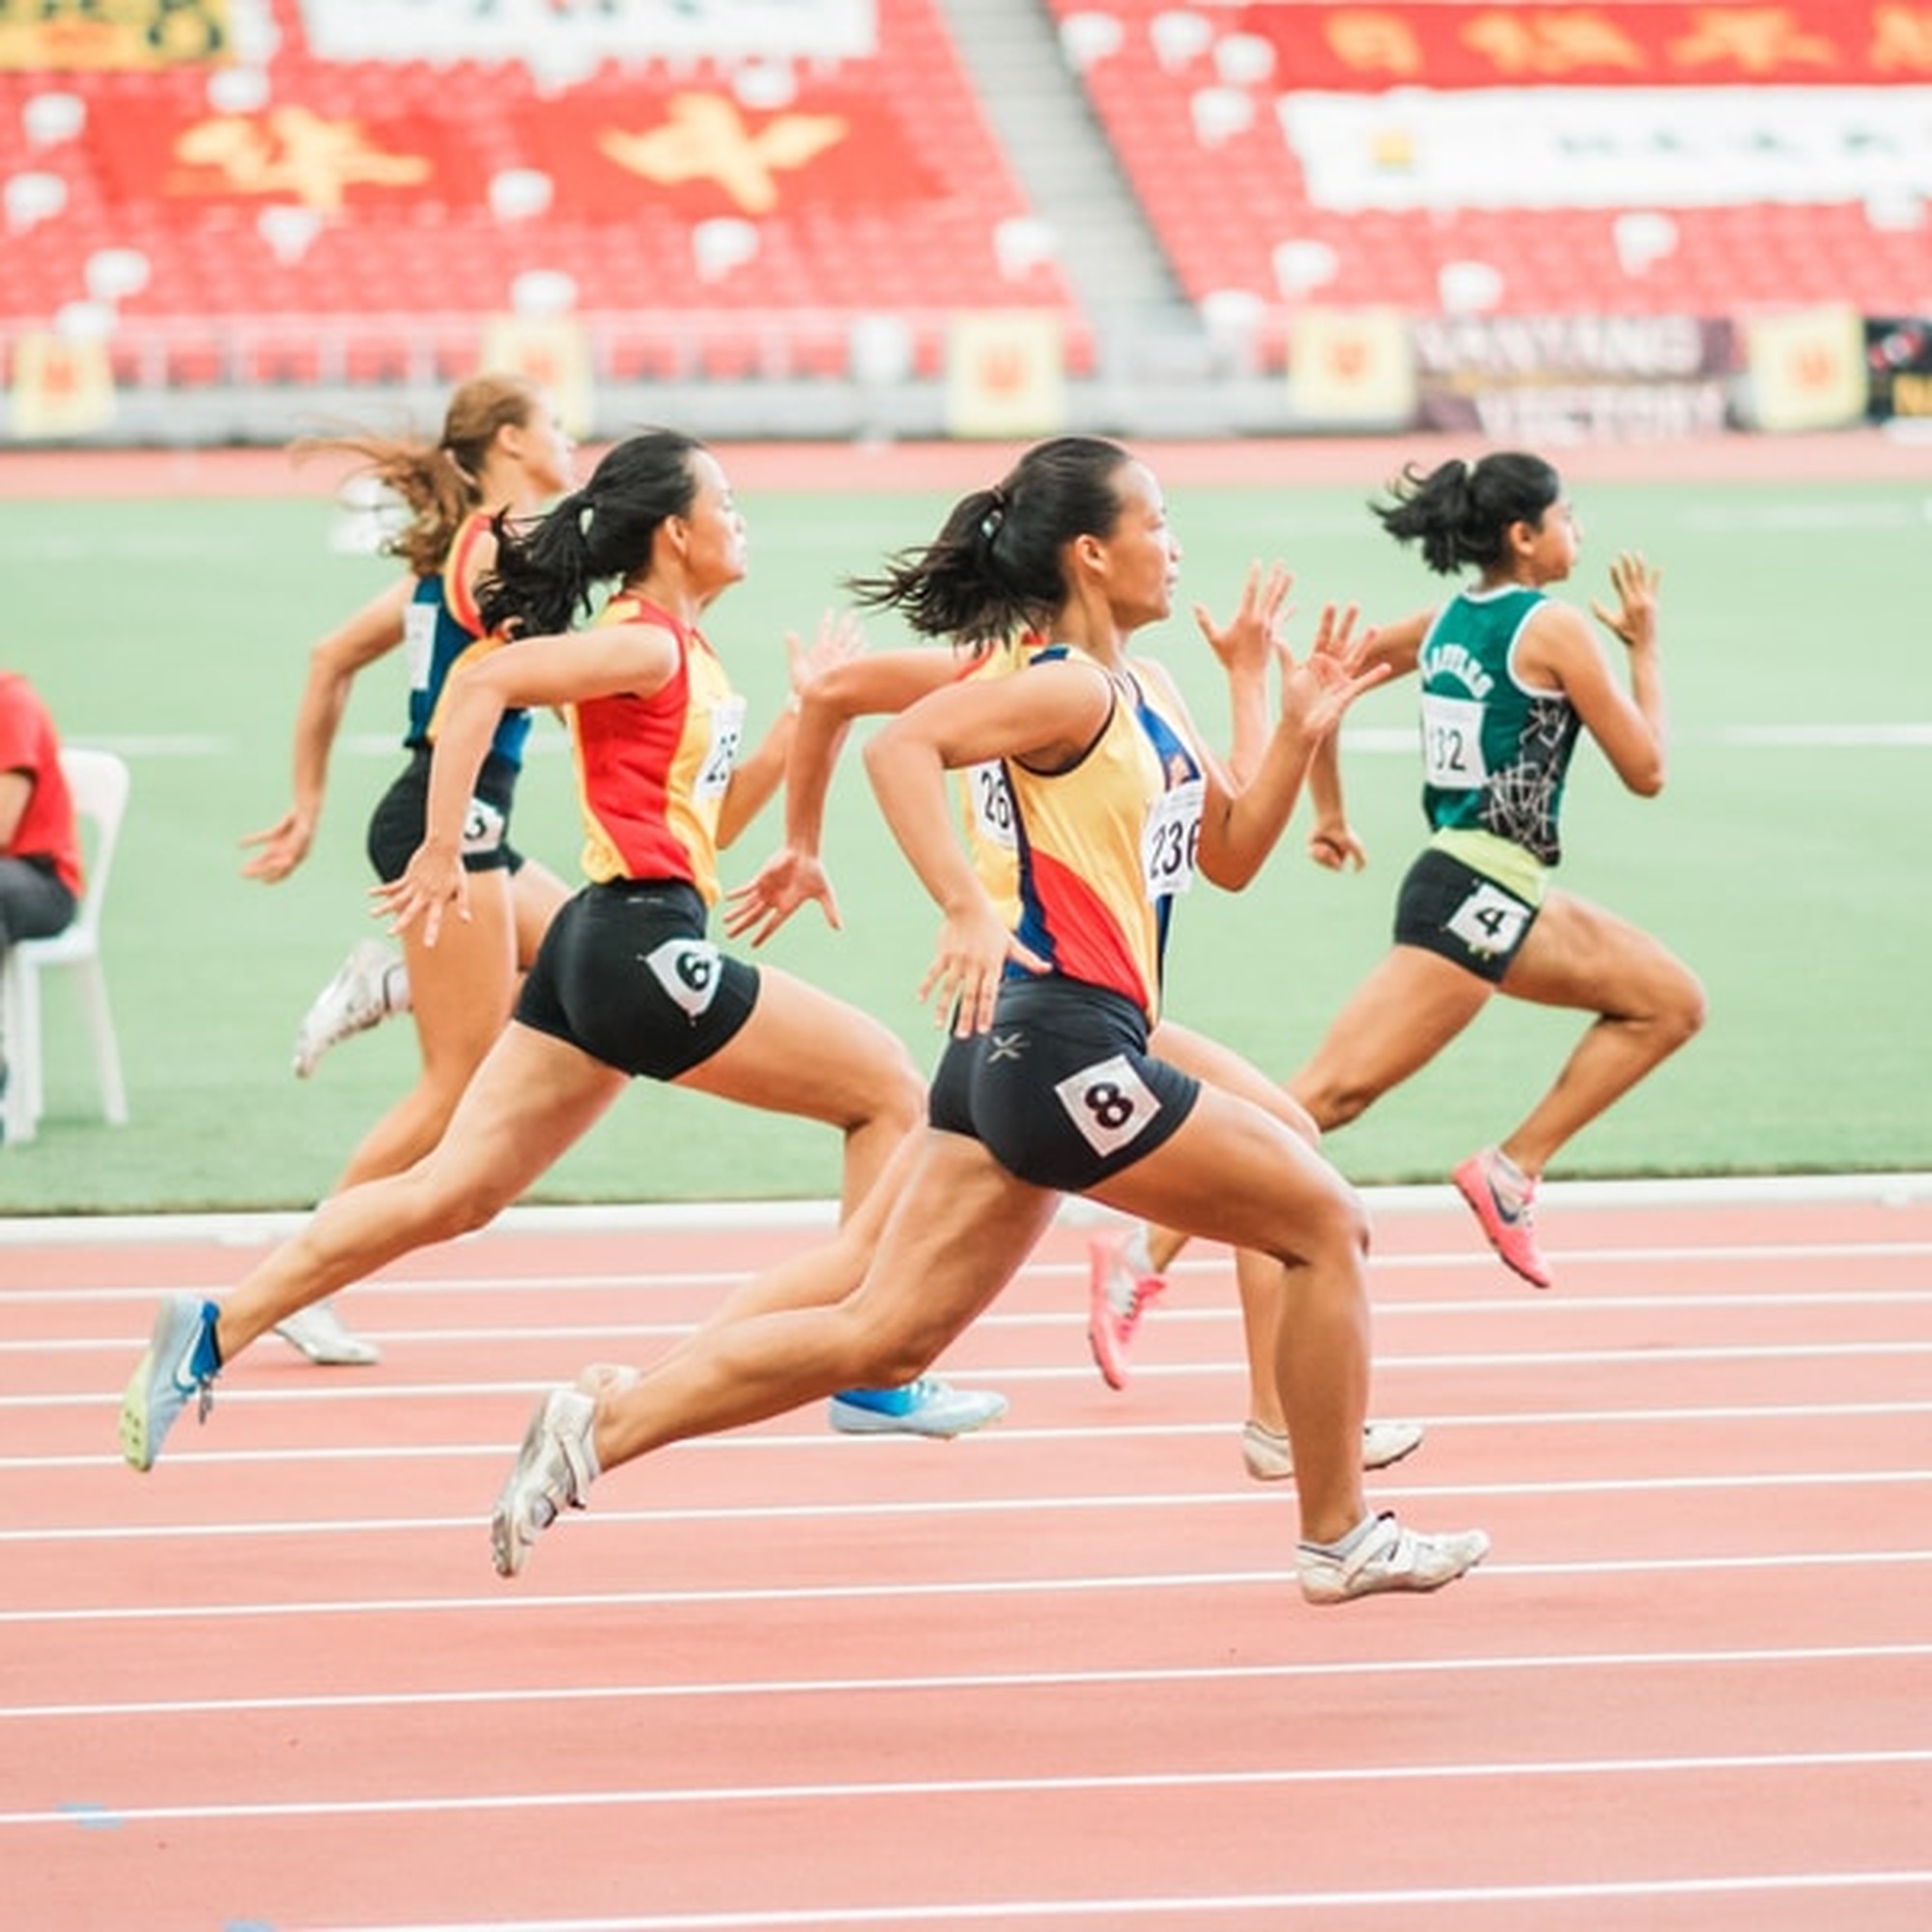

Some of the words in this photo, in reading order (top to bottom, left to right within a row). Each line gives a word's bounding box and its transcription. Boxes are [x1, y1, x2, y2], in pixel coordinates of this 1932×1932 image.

[1474, 906, 1507, 940] 4
[675, 951, 711, 993] 6
[1084, 1081, 1135, 1131] 8
